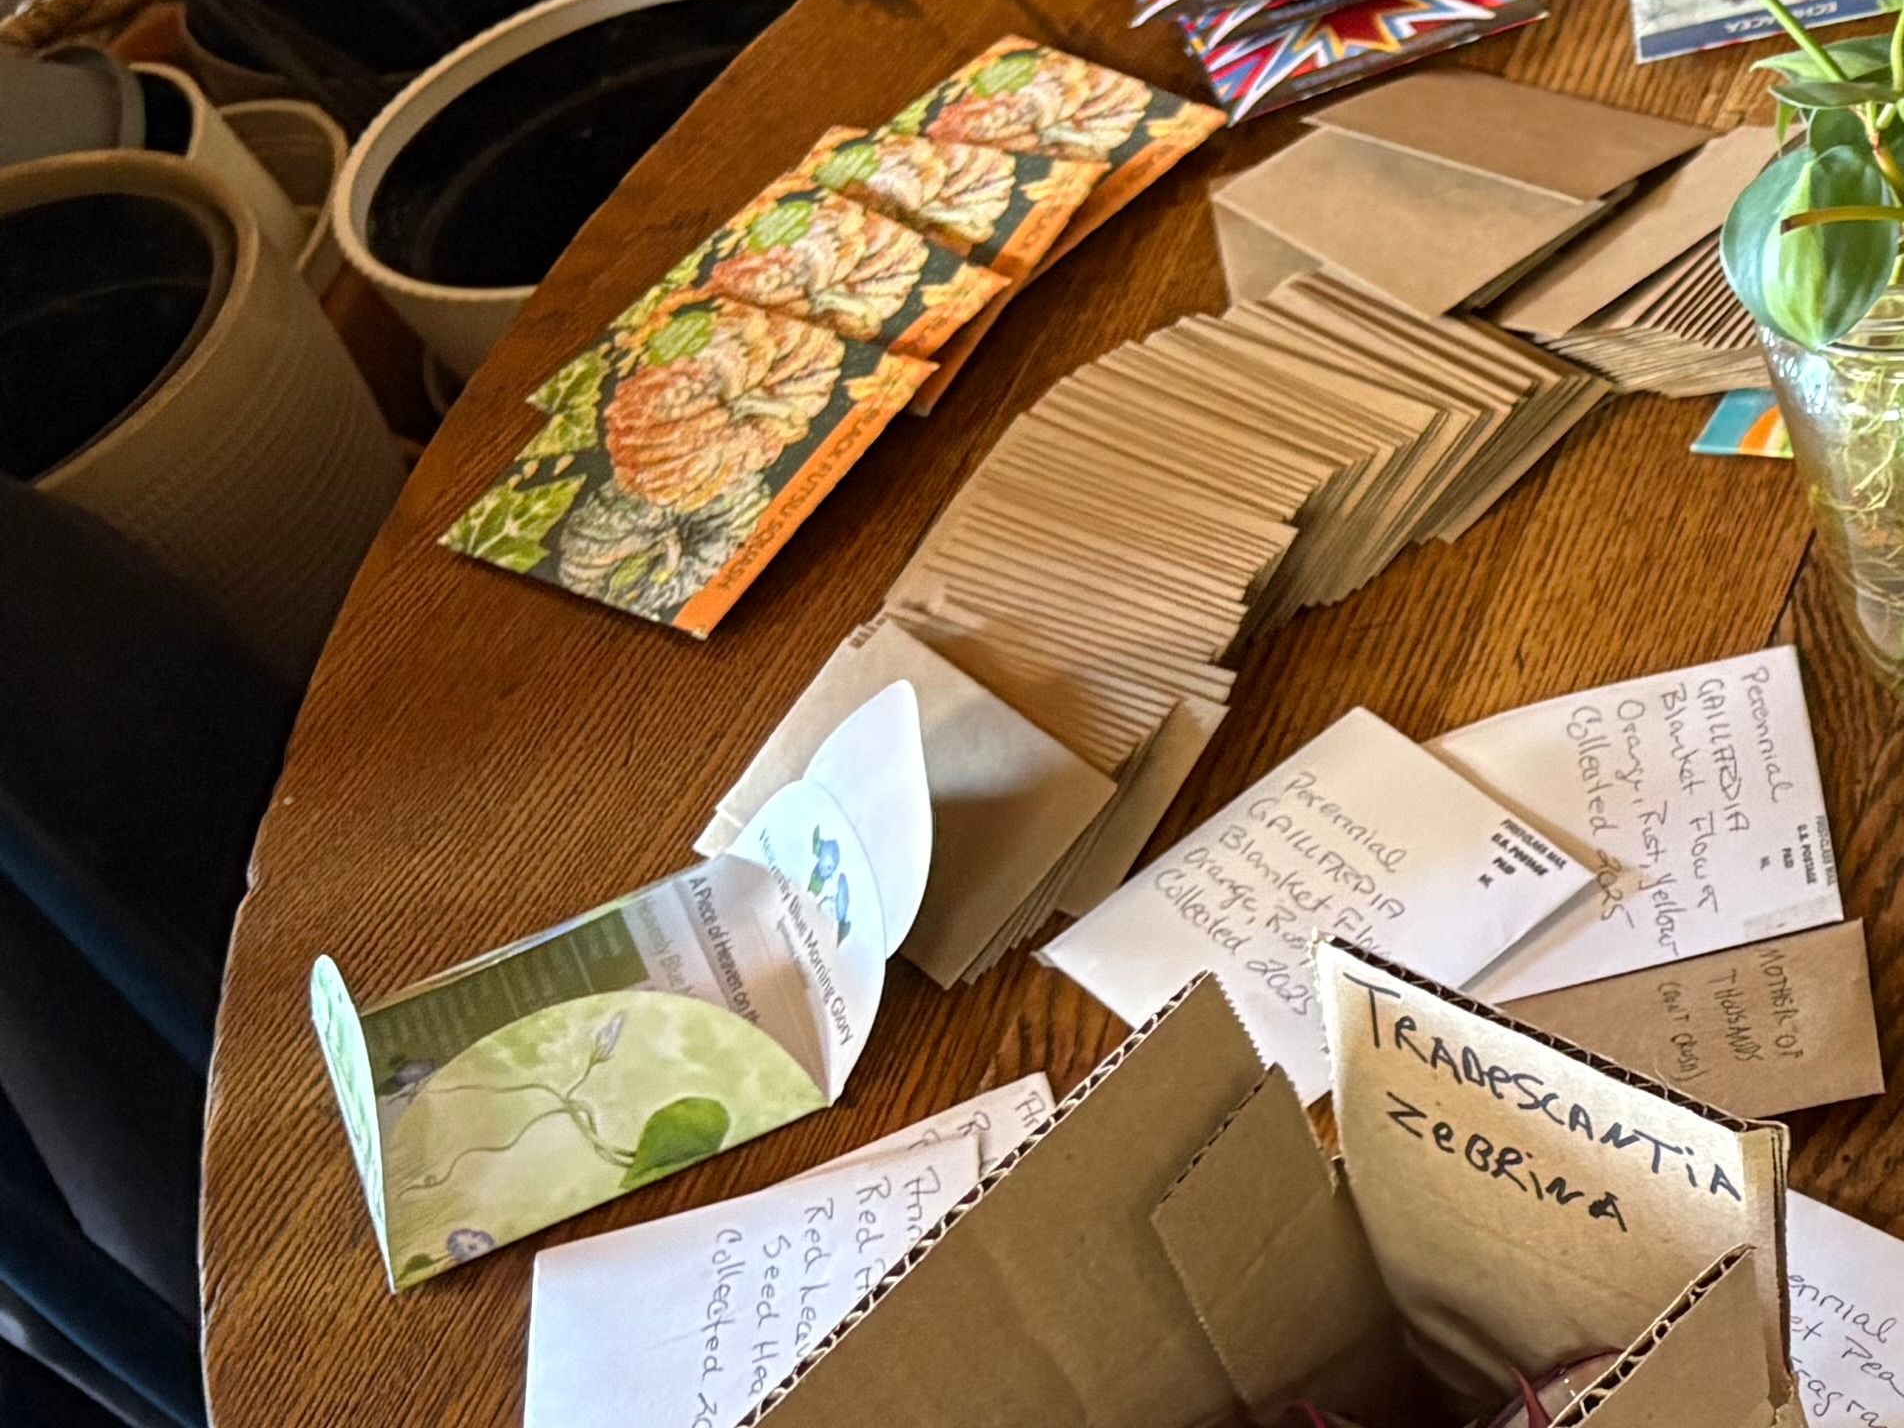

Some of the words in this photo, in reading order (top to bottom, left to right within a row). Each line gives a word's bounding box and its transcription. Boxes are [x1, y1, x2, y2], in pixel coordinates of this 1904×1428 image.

[1741, 665, 1795, 804] Perennial
[1283, 772, 1408, 874] Perennial
[1565, 705, 1620, 837] Collected
[1596, 849, 1636, 929] 2025
[713, 934, 744, 996] Heaven
[803, 930, 836, 1006] Morning
[830, 996, 853, 1047] Glory
[1154, 871, 1251, 957] Collected
[1247, 957, 1311, 1017] 2025
[802, 1199, 838, 1272] Red
[855, 1174, 893, 1249] Red
[701, 1228, 747, 1382] Collected
[759, 1235, 795, 1328] Seed
